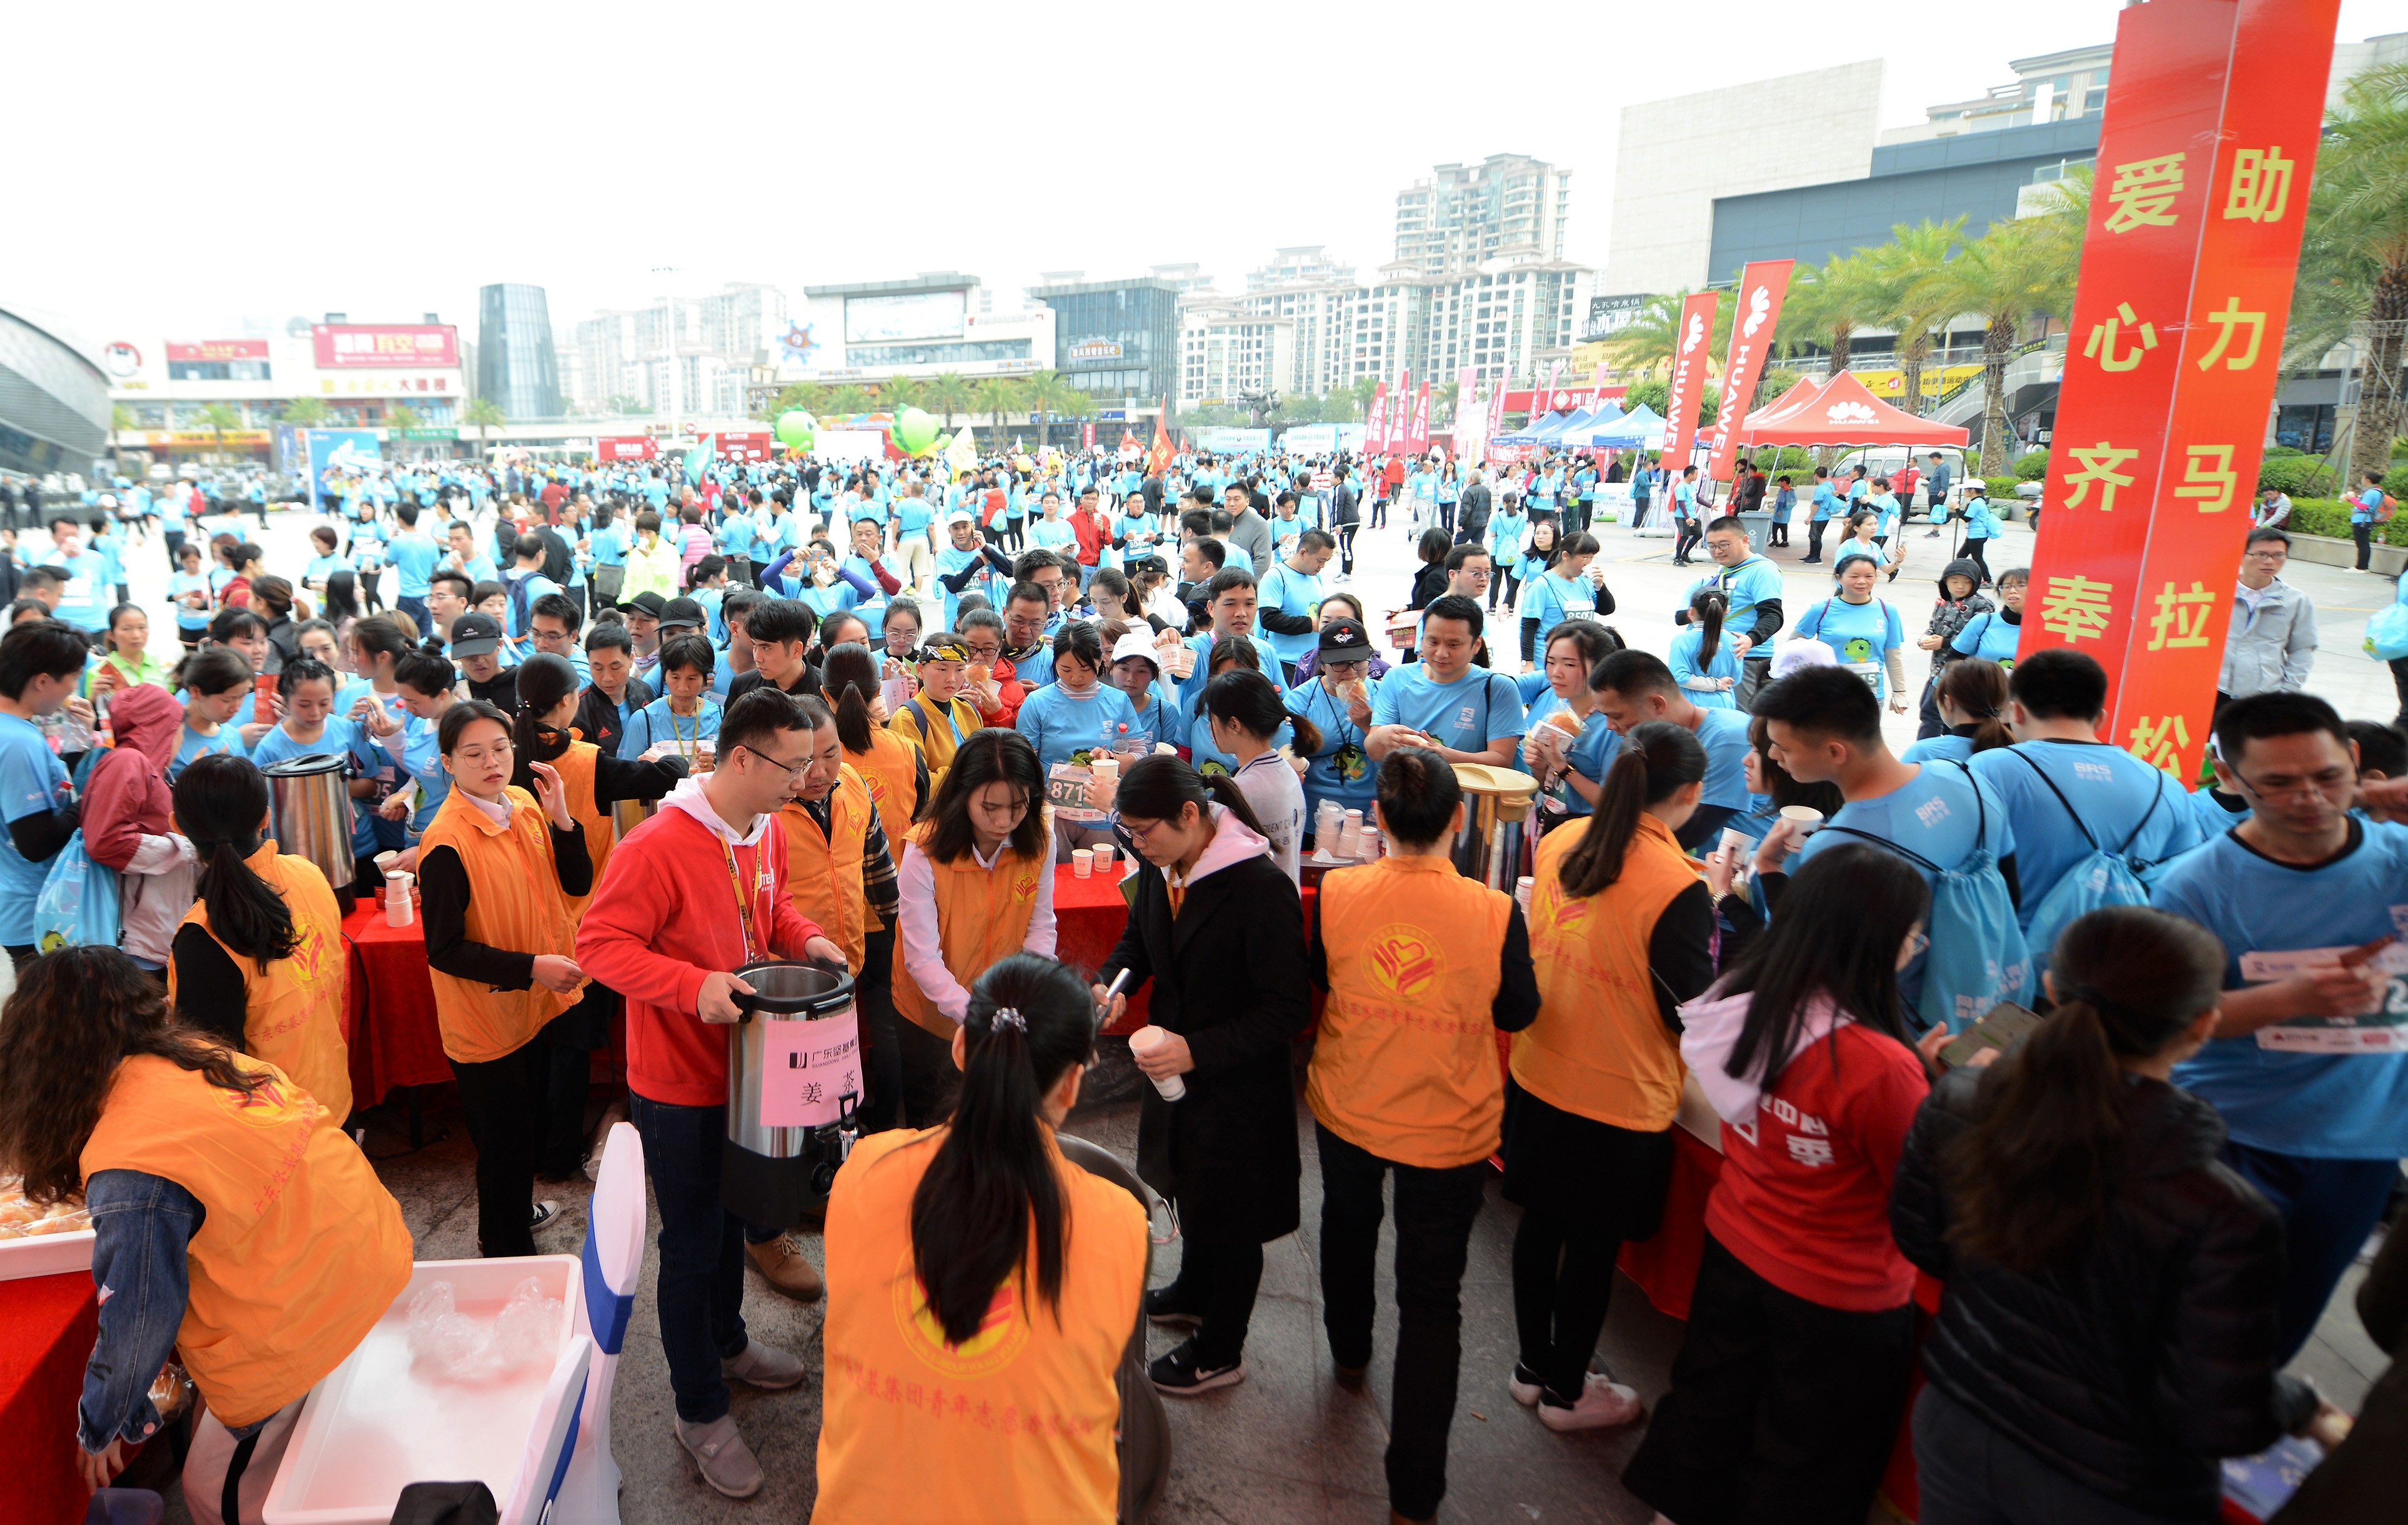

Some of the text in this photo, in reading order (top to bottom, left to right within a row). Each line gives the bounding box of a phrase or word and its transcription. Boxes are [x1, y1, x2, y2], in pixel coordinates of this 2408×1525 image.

[1663, 360, 1689, 453] HUAWEI
[1710, 345, 1750, 458] HUAWEI
[2129, 146, 2295, 779] 助力马拉松
